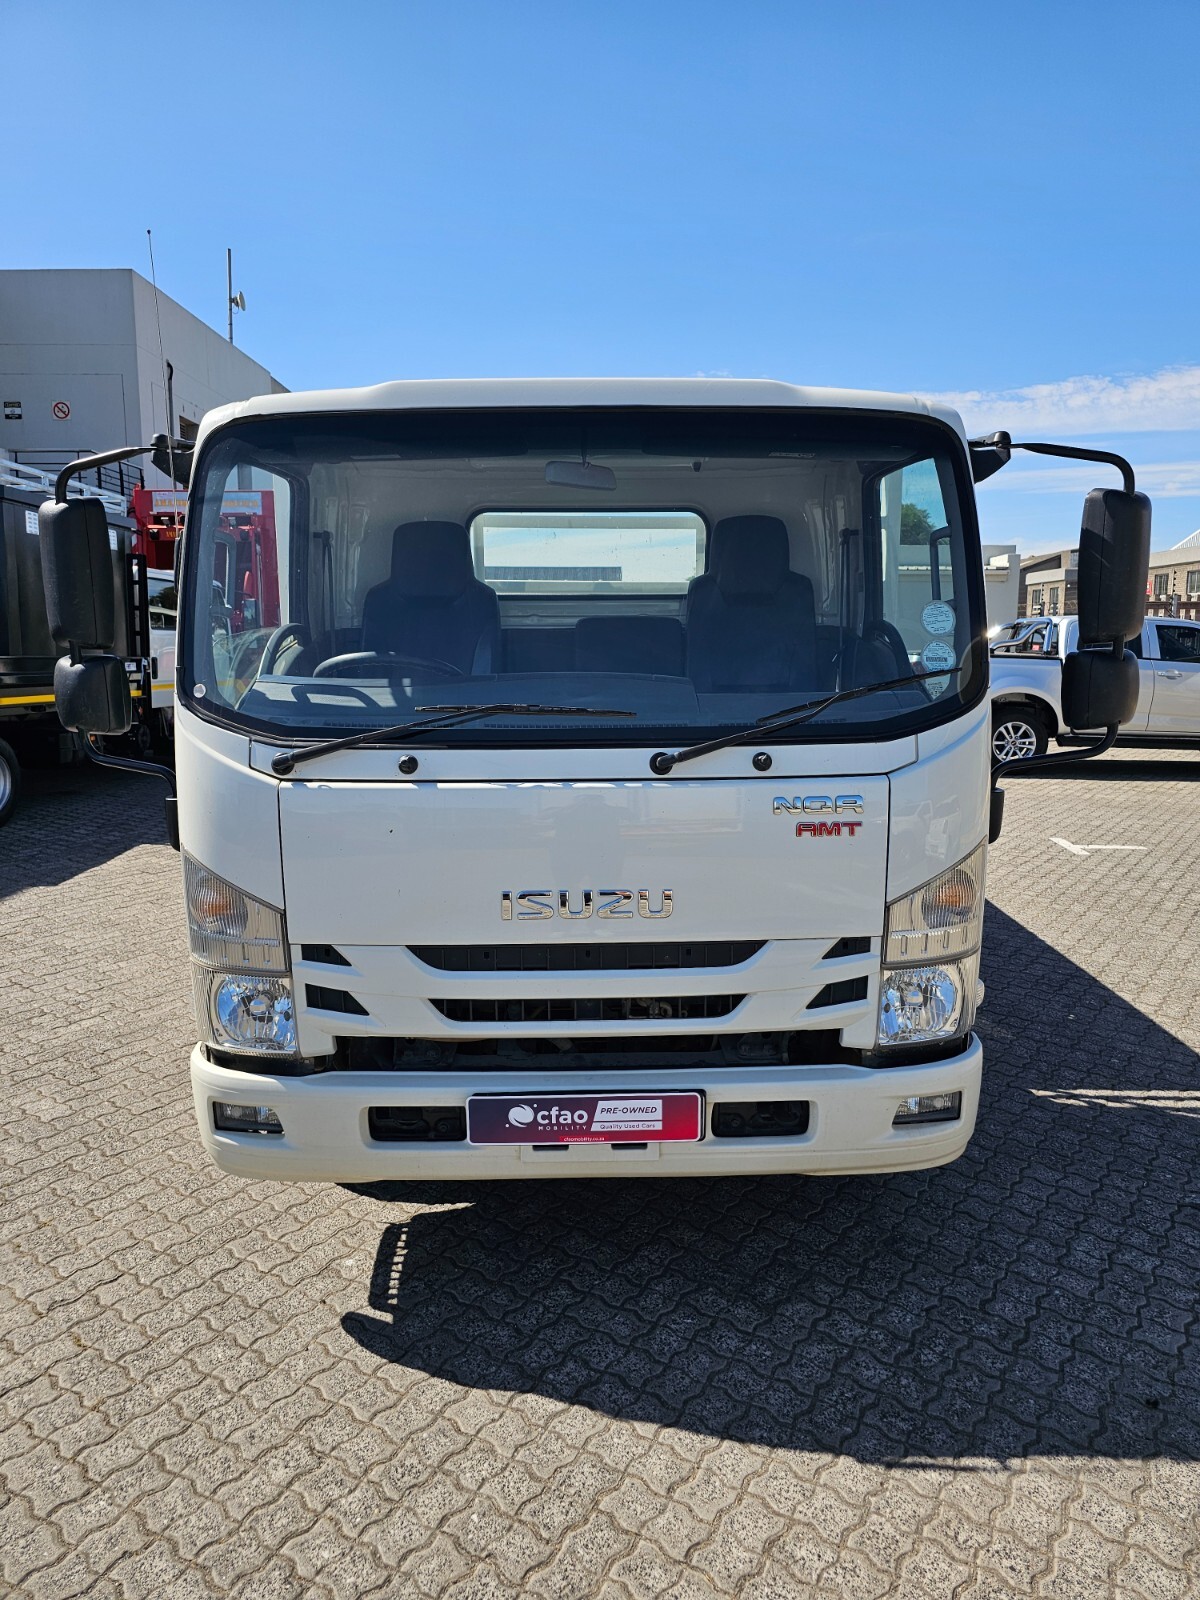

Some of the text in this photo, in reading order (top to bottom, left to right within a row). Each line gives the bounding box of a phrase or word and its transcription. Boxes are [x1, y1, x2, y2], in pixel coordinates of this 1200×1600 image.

[773, 794, 865, 815] NQR
[795, 820, 863, 837] AMT
[500, 889, 674, 921] ISUZU
[536, 1106, 588, 1124] cfao
[600, 1106, 658, 1114] PRE-OWNED
